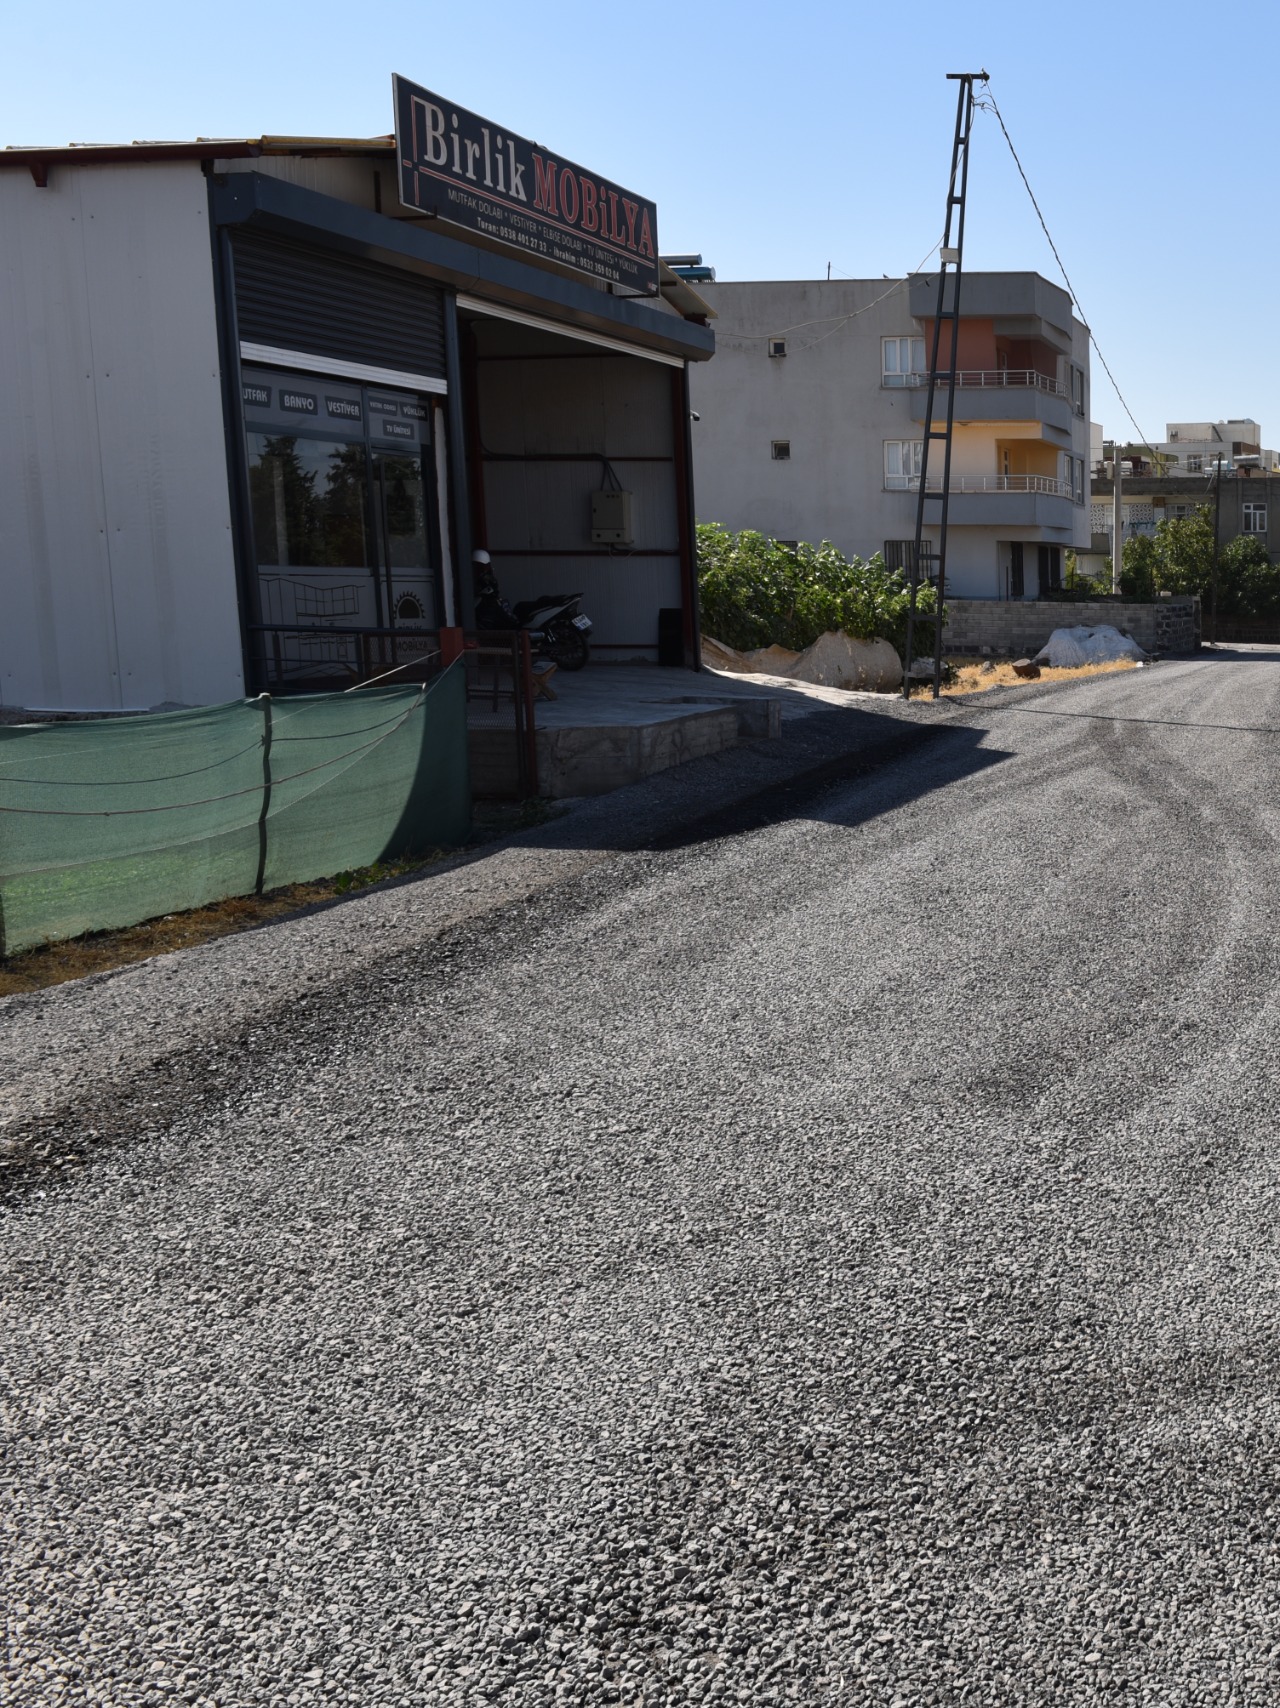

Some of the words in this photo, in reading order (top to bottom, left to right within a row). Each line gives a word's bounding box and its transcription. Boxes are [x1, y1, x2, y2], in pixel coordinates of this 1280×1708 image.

[422, 98, 528, 202] Birlik
[448, 188, 477, 210] MUTFAK
[478, 201, 503, 220] DOLABI
[587, 244, 595, 256] TV
[242, 388, 268, 402] UTFAK
[284, 394, 314, 410] BANYO
